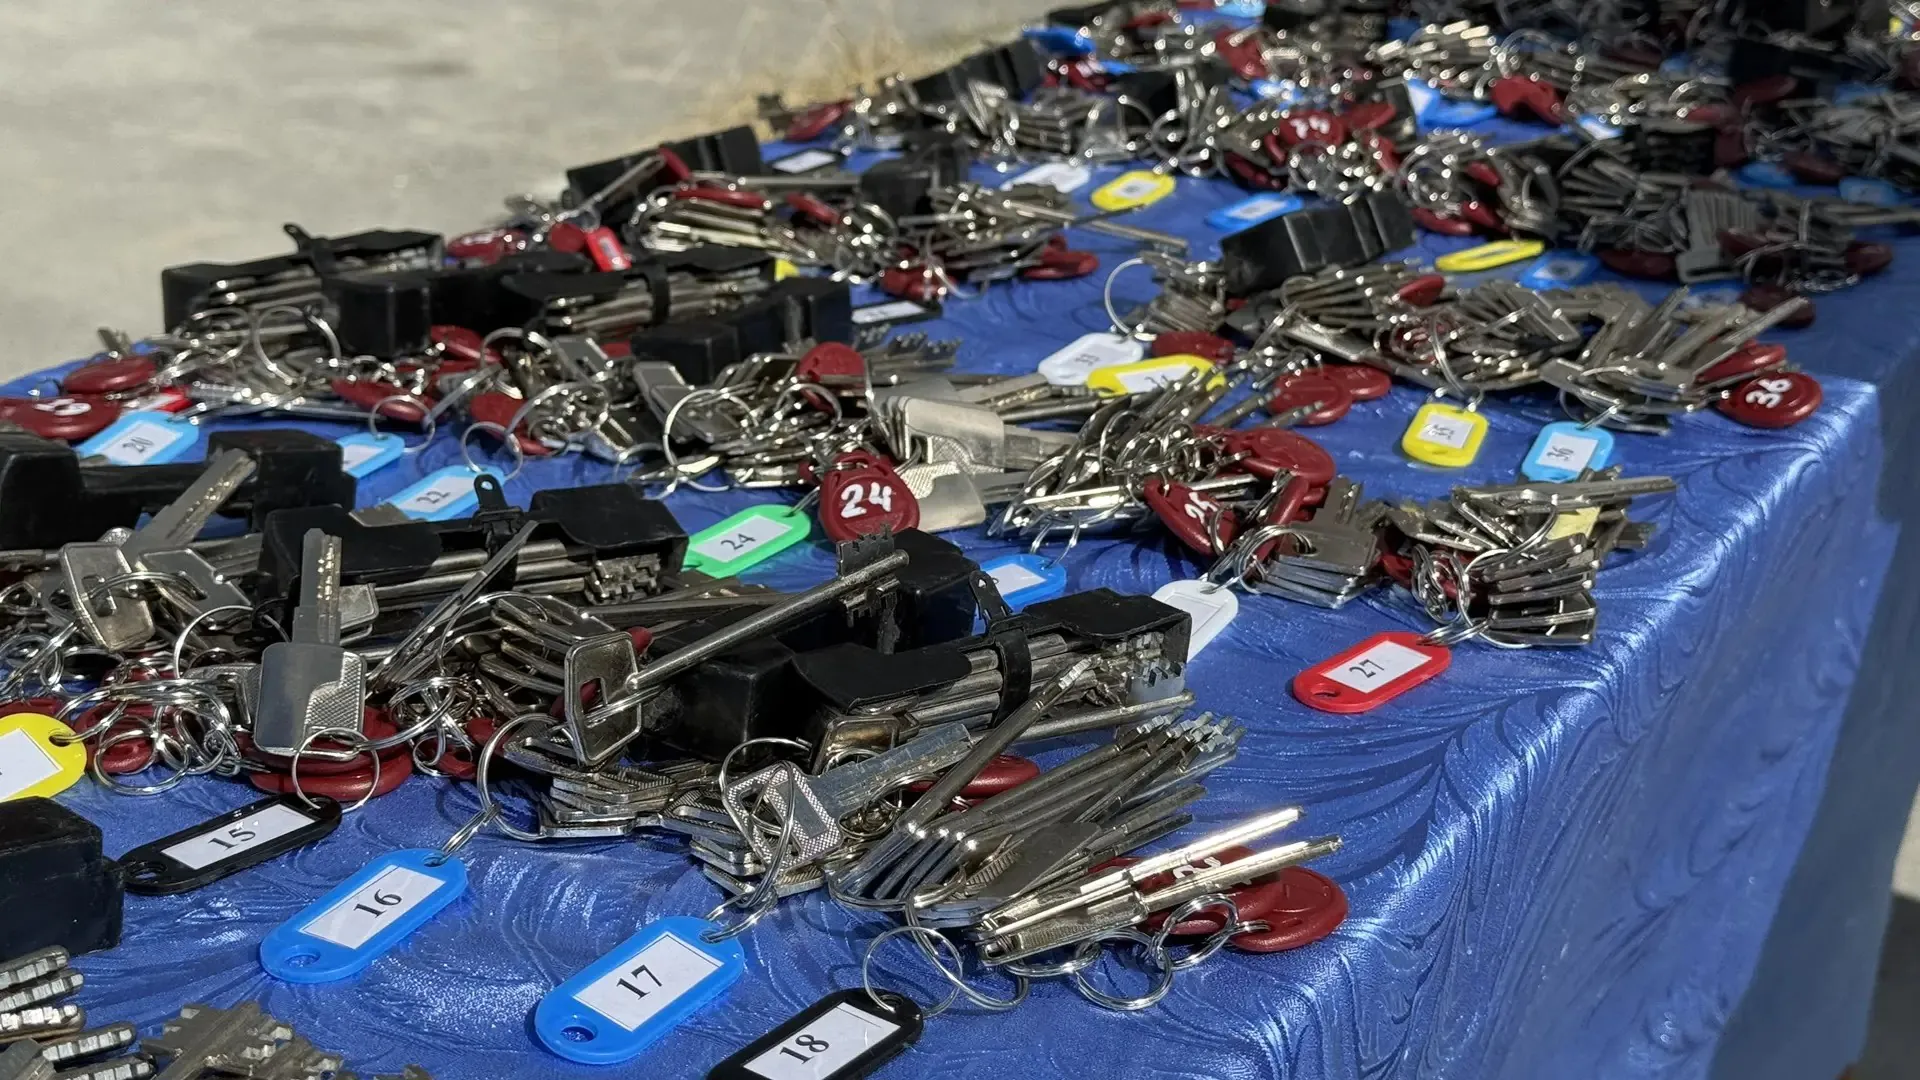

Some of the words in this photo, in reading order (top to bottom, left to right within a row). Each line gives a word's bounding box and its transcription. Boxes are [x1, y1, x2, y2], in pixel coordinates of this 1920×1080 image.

[1746, 378, 1793, 408] 36
[122, 438, 153, 454] 20
[1547, 445, 1575, 461] 36
[417, 490, 450, 506] 22
[841, 482, 893, 518] 24
[721, 533, 756, 550] 24
[1348, 658, 1385, 679] 27
[208, 826, 256, 849] 15
[353, 888, 403, 919] 16
[615, 964, 663, 1000] 17
[778, 1034, 830, 1065] 18
